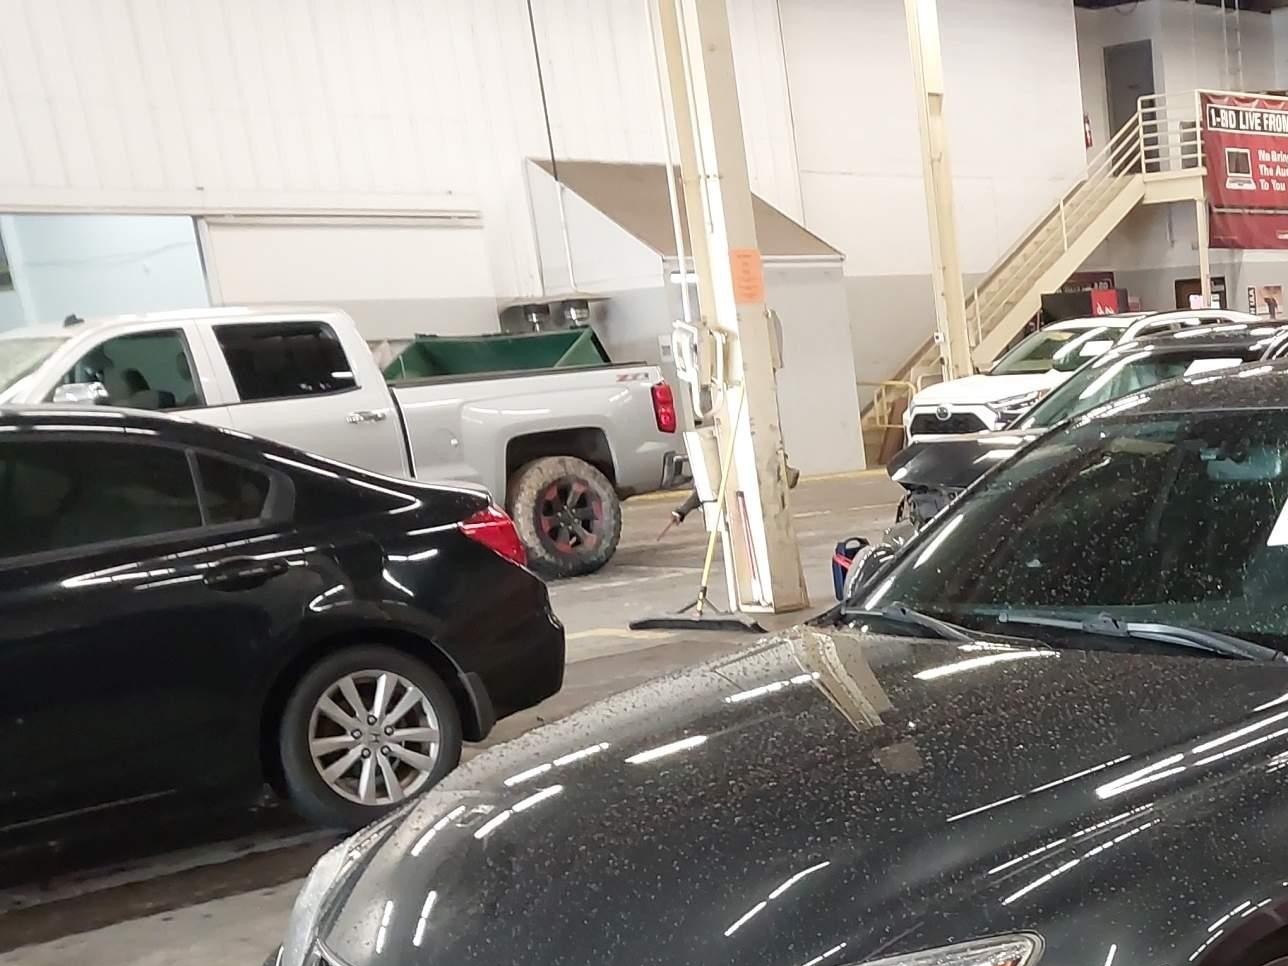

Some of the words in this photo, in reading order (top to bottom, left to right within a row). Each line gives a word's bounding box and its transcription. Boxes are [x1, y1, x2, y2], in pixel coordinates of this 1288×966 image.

[1239, 110, 1262, 131] LIVE
[1258, 164, 1274, 177] The
[1259, 179, 1270, 191] To
[1270, 179, 1286, 191] You
